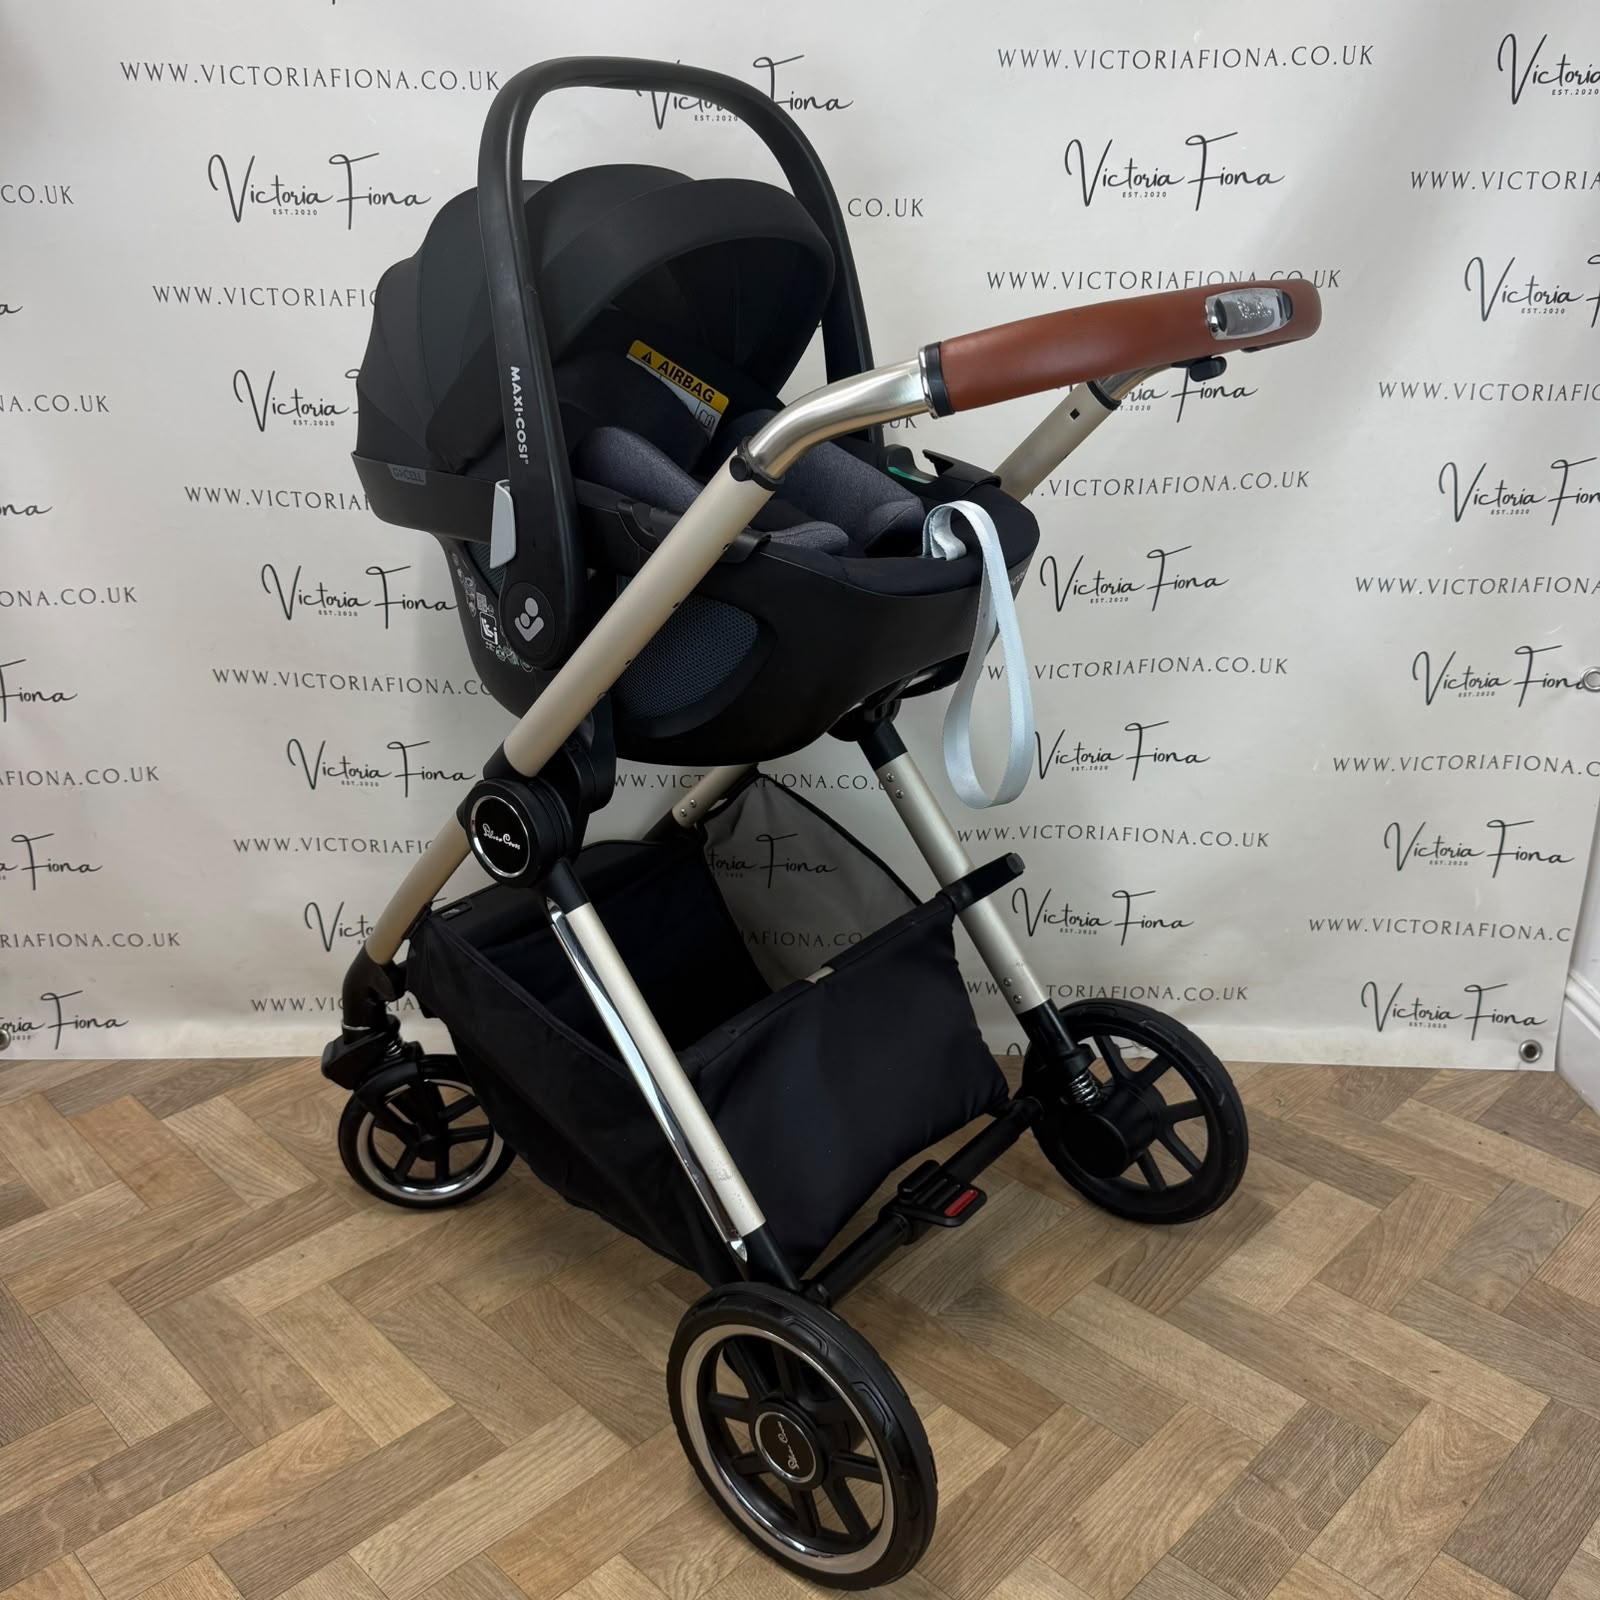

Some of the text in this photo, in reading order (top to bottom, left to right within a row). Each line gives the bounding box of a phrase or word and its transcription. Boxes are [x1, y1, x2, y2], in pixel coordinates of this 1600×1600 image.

[120, 61, 500, 91] WWW.VICTORIAFIONA.CO.UK
[998, 45, 1374, 70] WWW.VICTORIAFIONA.CO.UK
[208, 152, 431, 230] Victoria Fiona
[1064, 131, 1286, 211] Victoria Fiona
[272, 208, 318, 216] EST.2020
[1464, 256, 1584, 322] Victoria
[233, 369, 349, 432] Victoria
[657, 360, 715, 404] AIRBAG
[1438, 461, 1547, 522] Victoria
[261, 564, 372, 620] Victoria
[366, 565, 458, 629] Fiona
[1040, 545, 1229, 613] Victoria Fiona
[1412, 650, 1511, 706] Victoria
[287, 738, 476, 798] Victoria Fiona
[1035, 721, 1210, 781] Victoria Fiona
[11, 832, 103, 891] Fiona
[756, 833, 838, 889] Fiona
[957, 824, 1270, 848] WWW.VICTORIAFIONA.CO.UK
[1384, 819, 1575, 878] Victoria Fiona
[1012, 887, 1194, 946] Victoria Fiona
[40, 990, 130, 1050] Fiona
[1361, 981, 1548, 1041] Victoria Fiona
